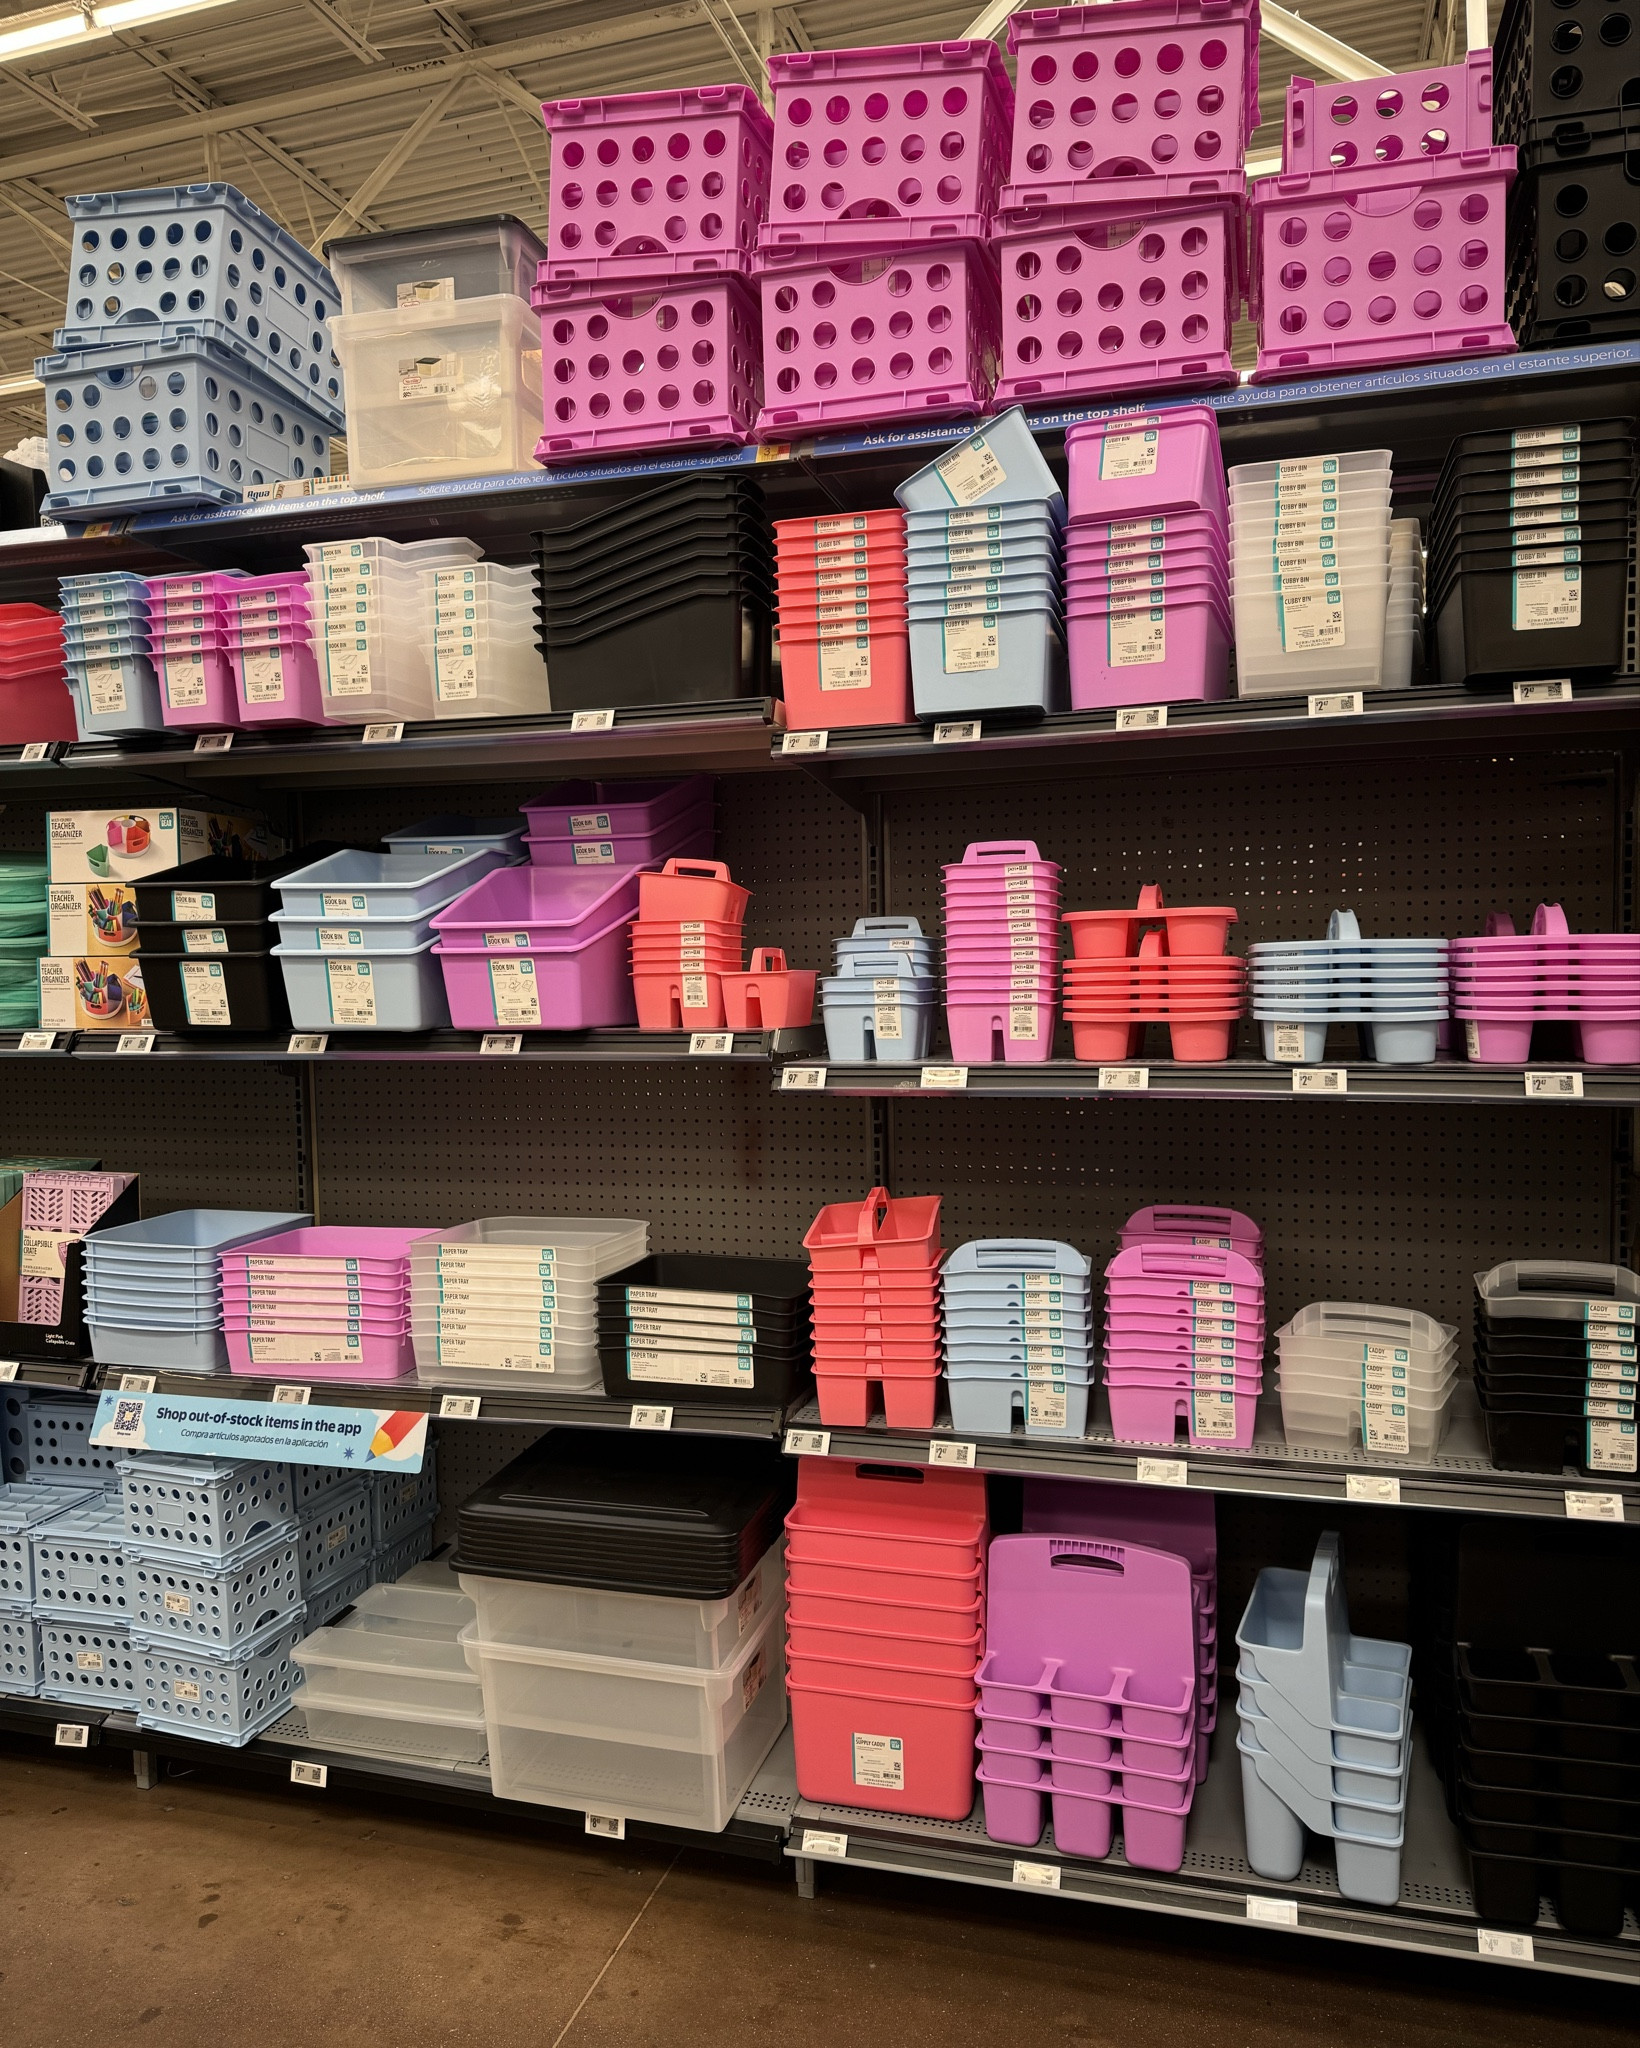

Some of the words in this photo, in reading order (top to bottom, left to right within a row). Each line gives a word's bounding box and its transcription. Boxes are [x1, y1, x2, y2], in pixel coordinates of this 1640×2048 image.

[1191, 393, 1235, 406] Solicite
[1237, 389, 1276, 403] ayuda
[1279, 387, 1307, 399] para
[1310, 379, 1362, 394] obtener
[1365, 373, 1420, 387] artículos
[1423, 362, 1479, 381] situados
[1482, 363, 1500, 373] en
[1504, 360, 1515, 371] el
[1519, 356, 1570, 369] estante
[1573, 347, 1633, 364] superior.
[1044, 414, 1059, 423] on
[1061, 410, 1084, 421] the
[1086, 409, 1110, 421] top
[1112, 404, 1148, 417] shelf.
[863, 435, 886, 445] Ask
[887, 432, 905, 443] for
[907, 424, 971, 440] assistance
[937, 458, 952, 470] CUBBY
[951, 452, 960, 461] BIN
[418, 484, 451, 496] Solicite
[452, 481, 481, 493] ayuda
[483, 480, 505, 490] para
[506, 475, 545, 486] obtener
[546, 469, 588, 482] artículos
[590, 463, 631, 477] situados
[633, 464, 647, 472] en
[648, 460, 659, 470] el
[660, 458, 697, 469] estante
[699, 453, 743, 466] superior.
[247, 490, 270, 500] Aqua
[170, 514, 188, 523] Ask
[189, 513, 202, 521] for
[204, 508, 252, 520] assistance
[254, 504, 275, 514] with
[277, 501, 304, 511] items
[321, 497, 338, 506] the
[339, 495, 357, 505] top
[359, 491, 386, 502] shelf.
[950, 512, 965, 520] CUBBY
[1518, 572, 1536, 580] CUBBY
[1284, 597, 1301, 605] CUBBY
[51, 822, 76, 830] TEACHER
[51, 830, 83, 838] ORGANIZER
[50, 894, 75, 902] TEACHER
[50, 902, 82, 910] ORGANIZER
[41, 976, 70, 984] ORGANIZER
[23, 1239, 53, 1248] COLLAPSIBLE
[23, 1247, 37, 1255] CRATE
[1592, 1362, 1611, 1370] CADDY
[156, 1407, 187, 1422] Shop
[189, 1411, 263, 1428] out-of-stock
[264, 1414, 299, 1430] items
[301, 1418, 313, 1431] in
[314, 1419, 336, 1433] the
[337, 1422, 362, 1437] app
[1591, 1420, 1610, 1428] CADDY
[180, 1428, 209, 1440] Compra
[209, 1429, 239, 1442] artículos
[239, 1434, 274, 1444] agotados
[284, 1436, 291, 1446] la
[291, 1437, 329, 1449] aplicación
